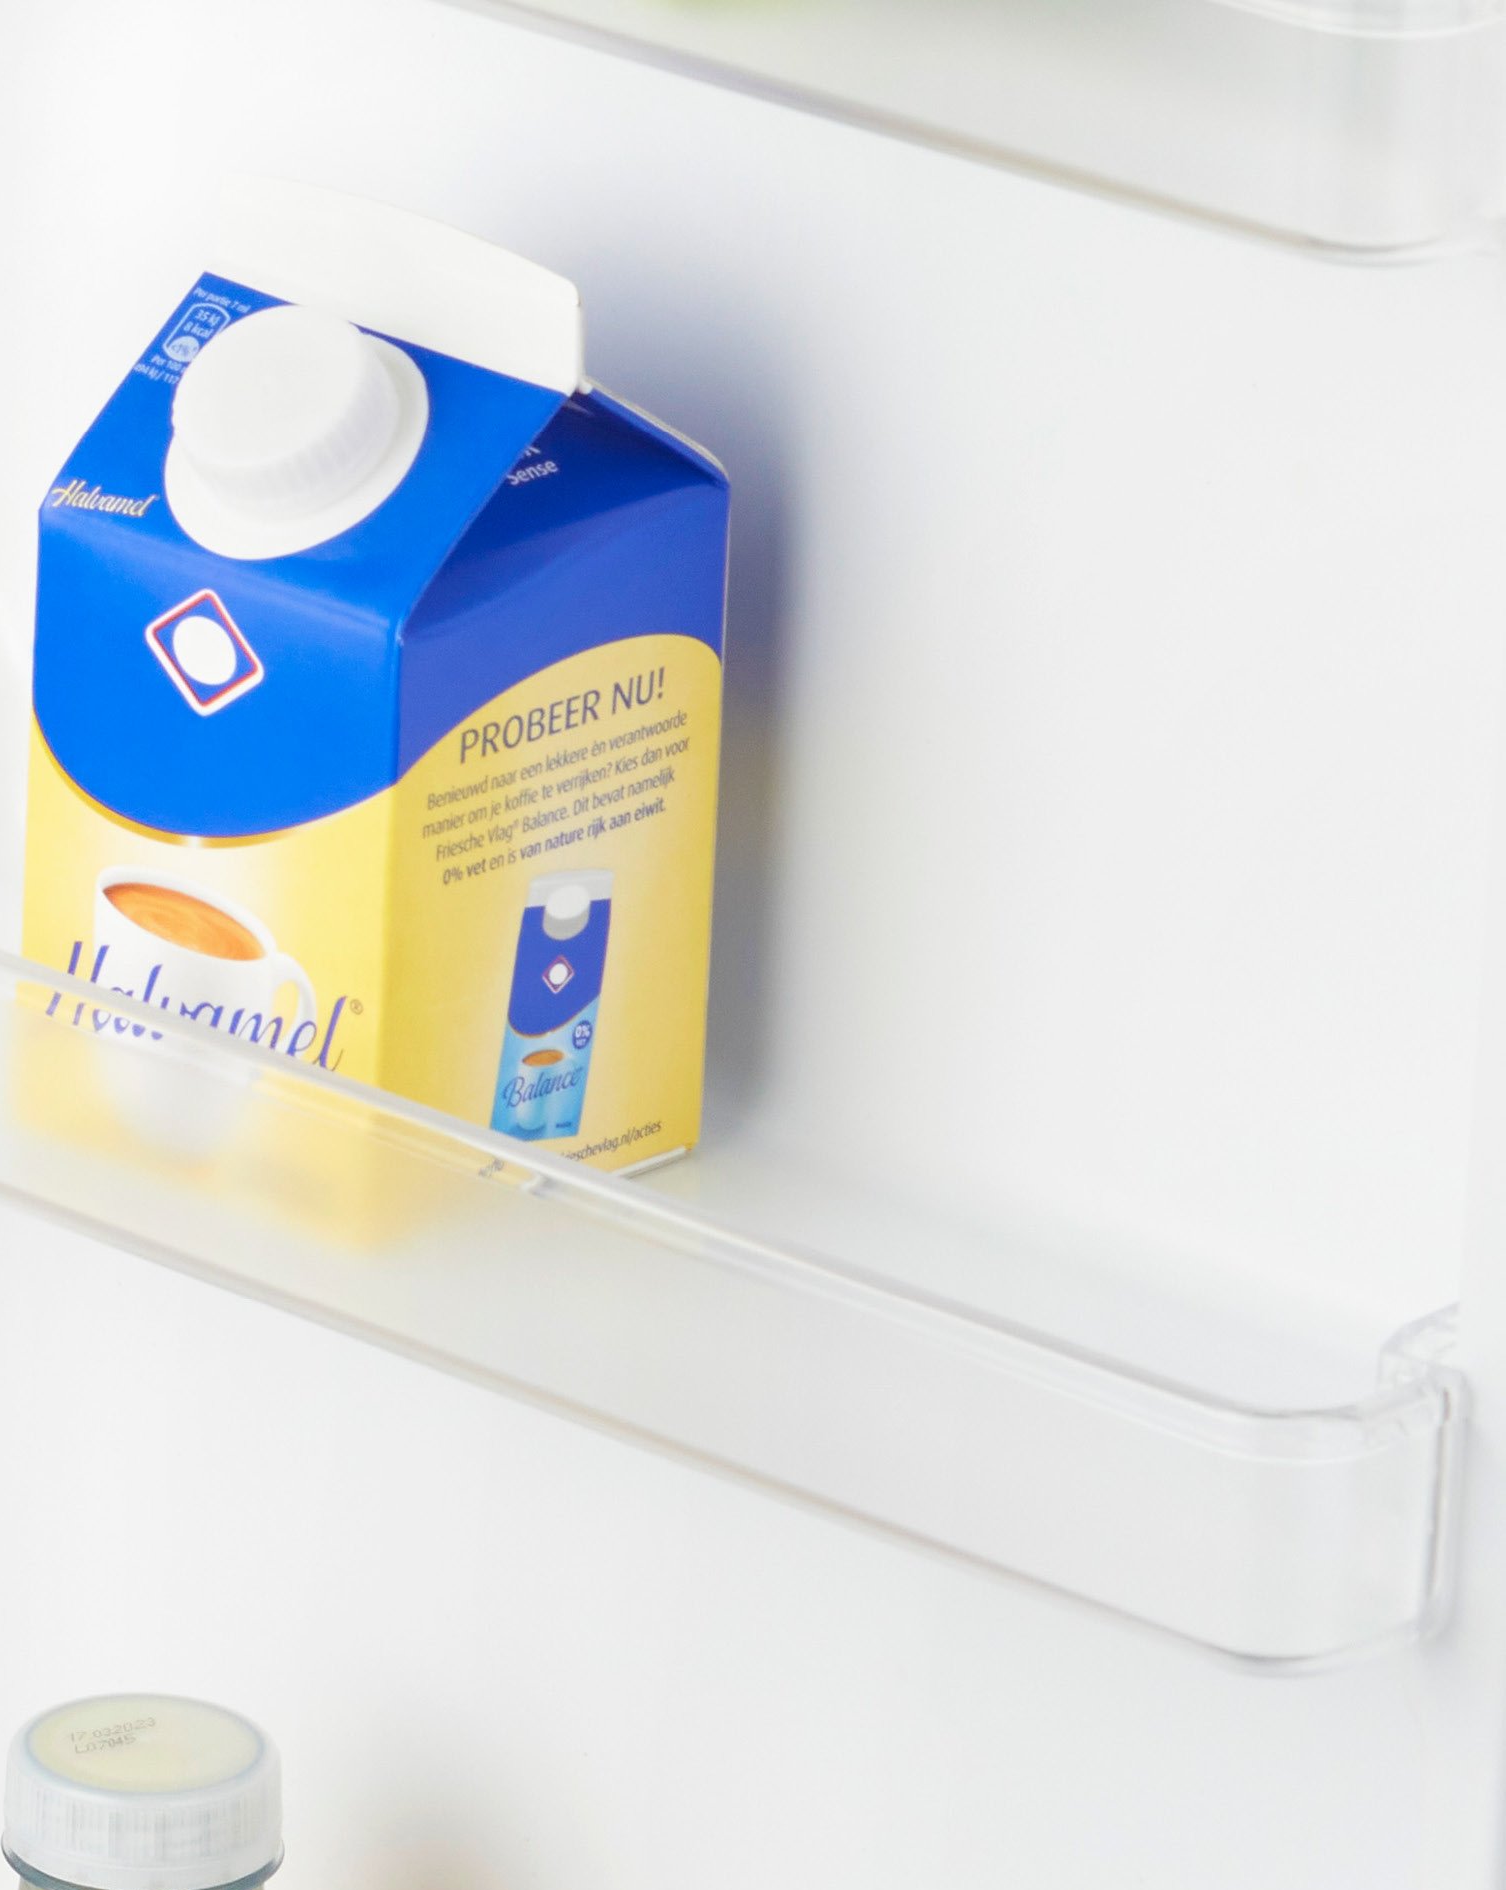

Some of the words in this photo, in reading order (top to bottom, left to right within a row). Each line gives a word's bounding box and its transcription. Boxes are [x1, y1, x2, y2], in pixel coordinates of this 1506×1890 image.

[52, 479, 160, 519] Halvamel
[427, 776, 489, 810] Benieuwd
[490, 769, 517, 788] naar
[519, 762, 543, 780] een
[545, 741, 588, 772] lekkere
[608, 708, 688, 751] verantwoorde
[458, 689, 602, 765] PROBEER
[609, 666, 667, 717] NU!
[422, 808, 466, 839] manier
[467, 804, 488, 824] om
[489, 797, 502, 821] je
[503, 783, 539, 812] koffie
[541, 780, 553, 799] te
[555, 761, 612, 798] verrijken?
[614, 750, 639, 775] Kies
[640, 742, 663, 766] dan
[664, 735, 690, 758] voor
[435, 829, 485, 862] Friesche
[521, 800, 570, 833] Balance.
[572, 793, 589, 815] Dit
[591, 782, 625, 809] bevat
[627, 764, 675, 799] namelijk
[442, 863, 464, 886] 0%
[465, 854, 487, 877] vet
[488, 852, 506, 870] en
[507, 846, 516, 863] is
[518, 838, 543, 860] van
[544, 824, 584, 851] nature
[586, 815, 605, 841] rijk
[608, 810, 630, 830] aan
[632, 794, 667, 822] eiwit.
[574, 1024, 591, 1039] 0%
[502, 1068, 580, 1109] Balance
